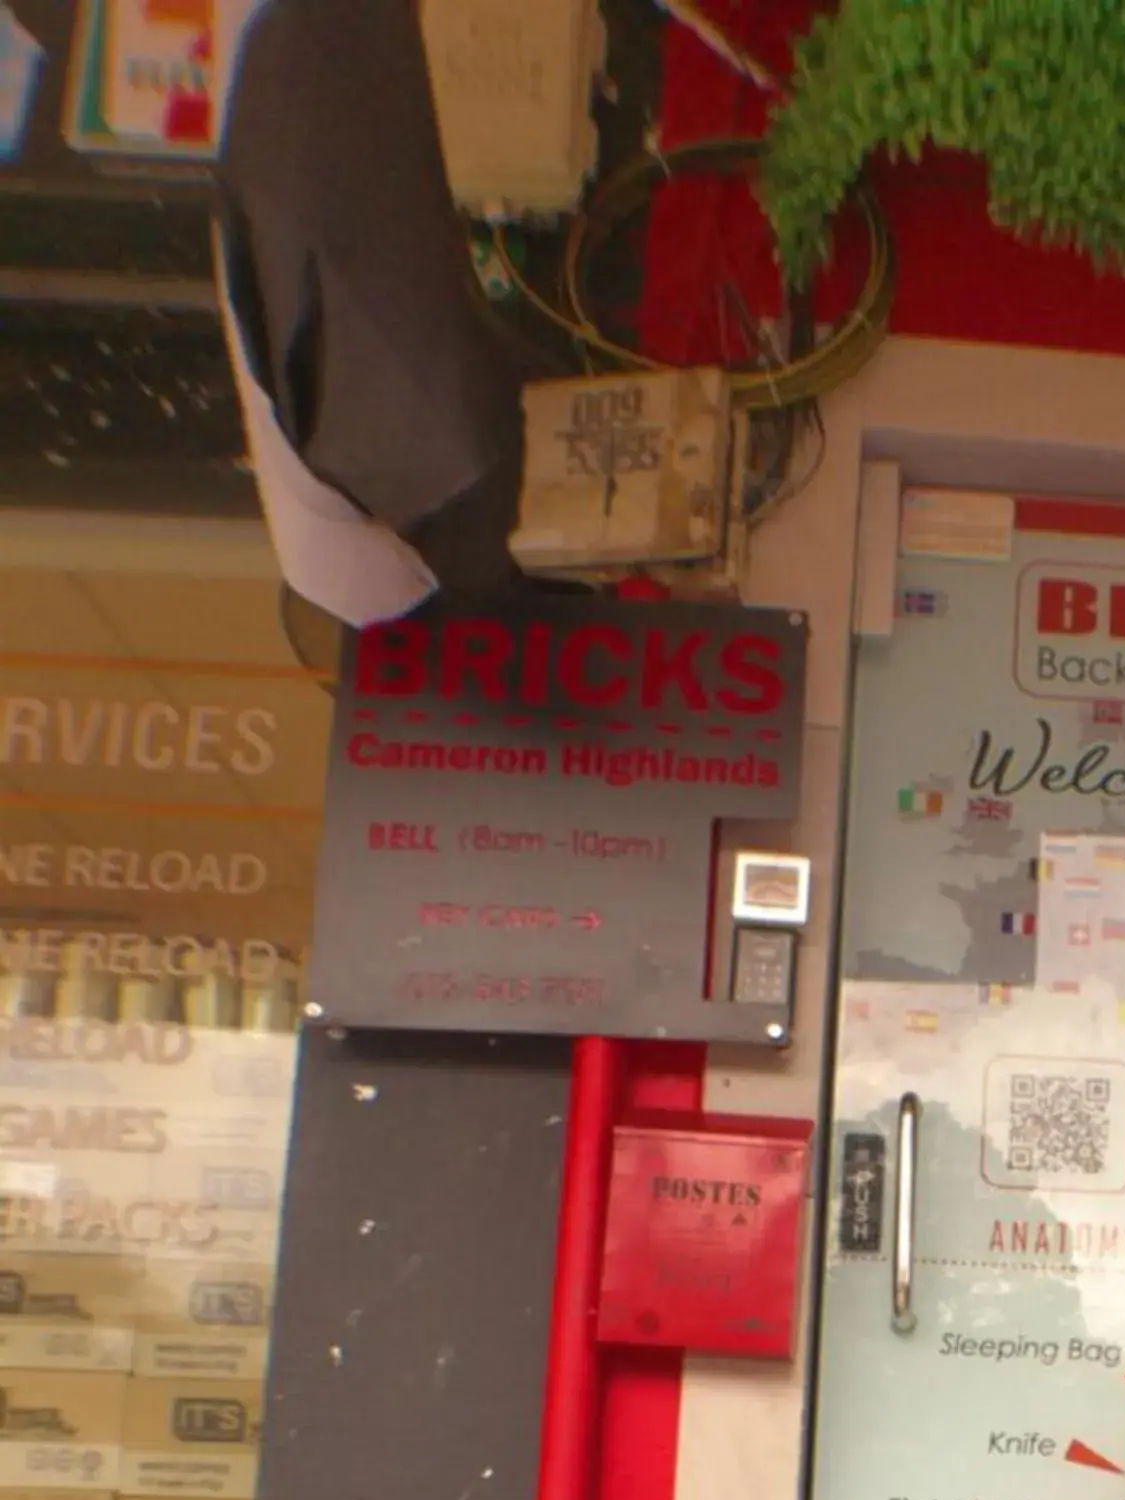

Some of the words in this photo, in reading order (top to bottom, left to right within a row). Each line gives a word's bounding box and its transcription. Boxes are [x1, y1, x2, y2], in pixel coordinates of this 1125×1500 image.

[354, 616, 788, 716] BRICKS
[346, 732, 547, 775] Cameron
[561, 738, 781, 788] Highlands
[368, 822, 439, 852] BELL
[64, 845, 267, 894] RELOAD
[651, 1176, 762, 1206] POSTES
[938, 1331, 1060, 1367] Sleeping
[1067, 1337, 1122, 1368] Bag
[987, 1431, 1057, 1457] Knife
